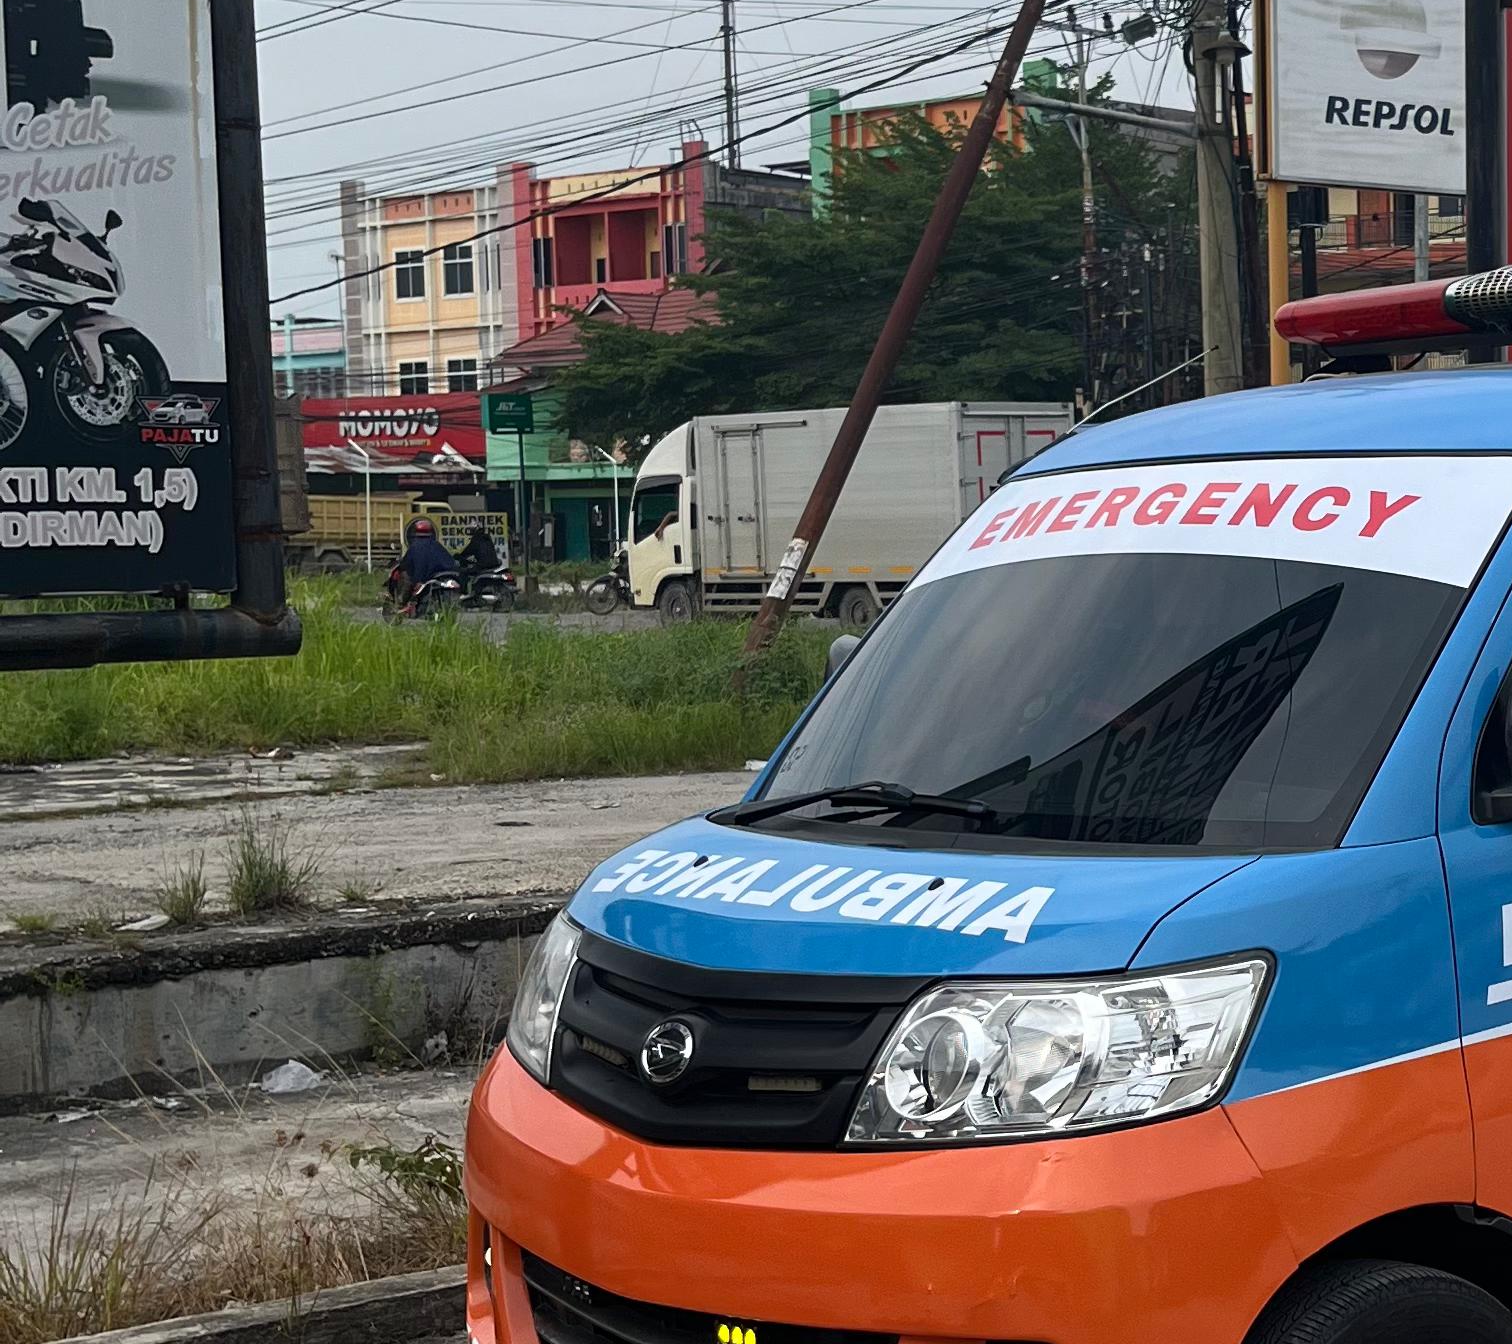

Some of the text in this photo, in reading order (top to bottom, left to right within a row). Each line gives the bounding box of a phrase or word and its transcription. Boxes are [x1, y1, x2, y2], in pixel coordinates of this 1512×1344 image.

[4, 96, 113, 151] Cetak
[1325, 95, 1455, 136] REPSOL
[141, 428, 219, 443] PAJATU
[338, 408, 440, 437] MOMOYO
[55, 467, 127, 502] KM.
[133, 467, 198, 510] 1,5)
[968, 482, 1422, 551] EMERGENCY
